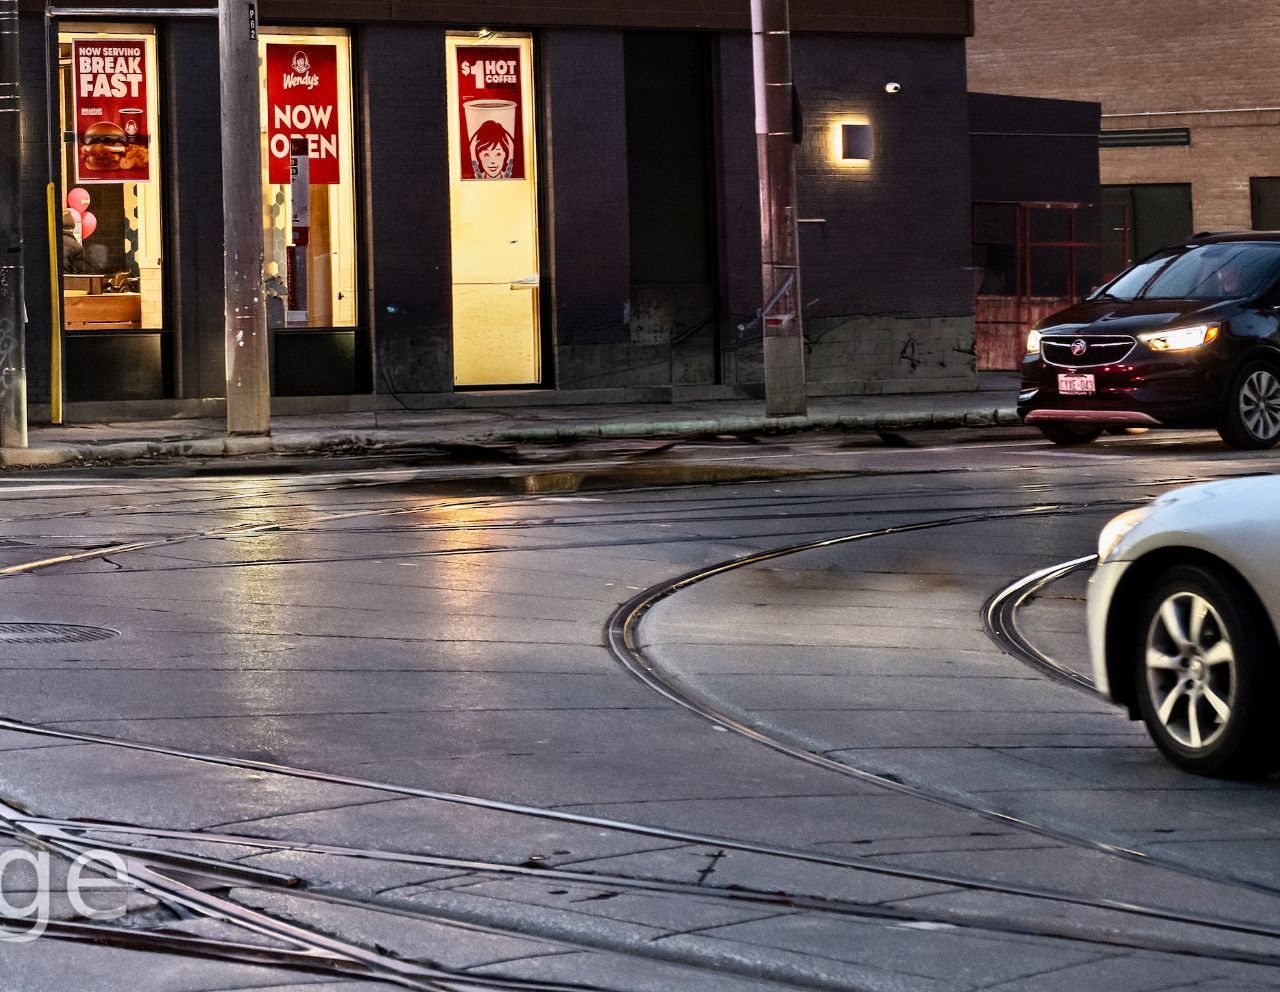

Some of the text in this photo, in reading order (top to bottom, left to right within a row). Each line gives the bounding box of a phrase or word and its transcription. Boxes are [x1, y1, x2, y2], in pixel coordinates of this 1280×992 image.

[80, 47, 141, 56] NOW SERVING
[80, 57, 142, 73] BREAK
[461, 60, 517, 89] $1 HOT
[80, 74, 142, 98] FAST
[283, 71, 319, 90] Wendy's
[485, 75, 517, 83] COFFEE
[274, 104, 333, 129] NOW
[270, 133, 337, 159] OEN
